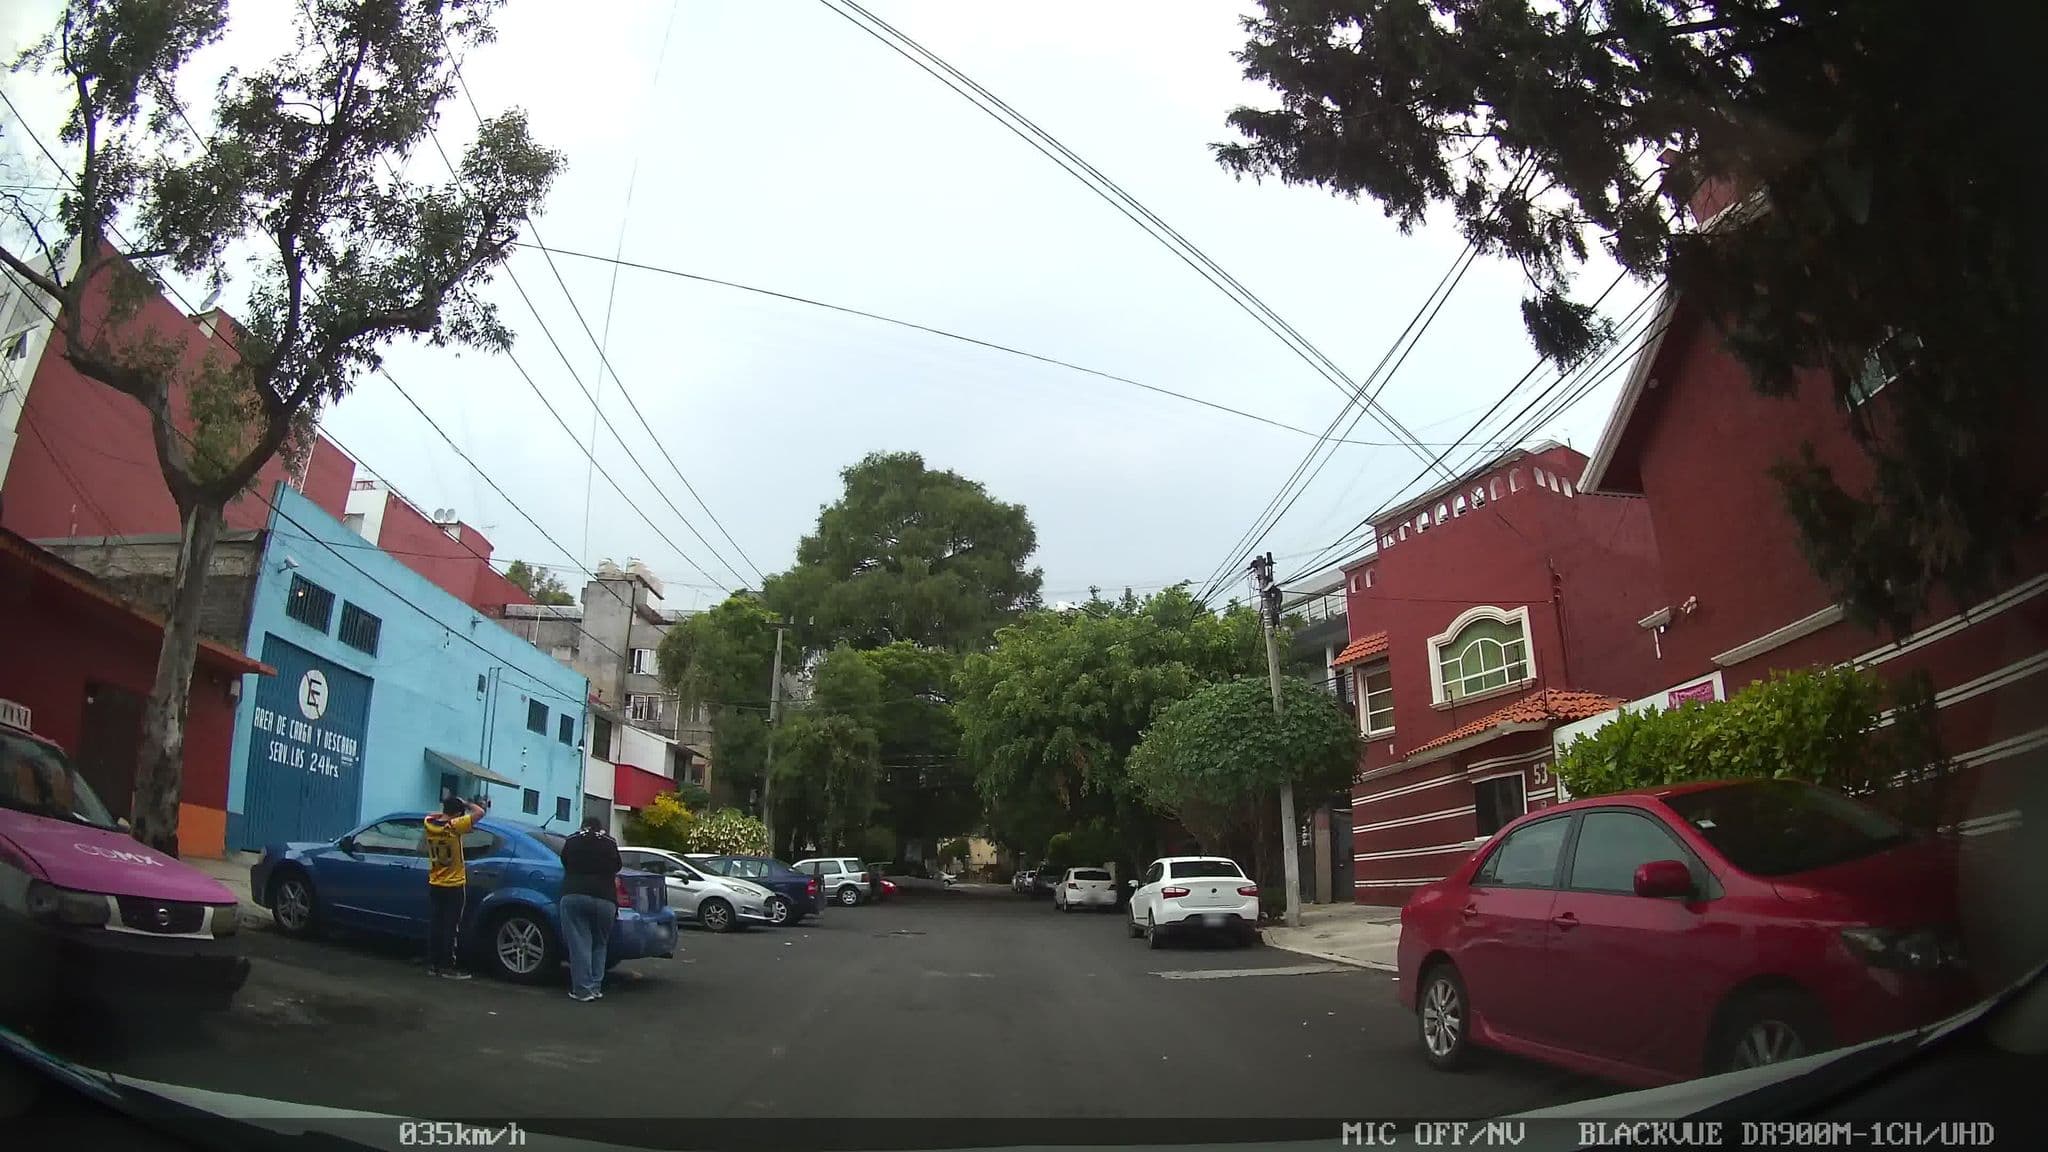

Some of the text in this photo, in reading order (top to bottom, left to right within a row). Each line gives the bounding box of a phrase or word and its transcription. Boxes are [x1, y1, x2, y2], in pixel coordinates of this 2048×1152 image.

[254, 707, 274, 731] AREA
[276, 714, 287, 736] DE
[289, 719, 313, 744] CARGA
[316, 728, 322, 747] Y
[1533, 762, 1548, 785] 53
